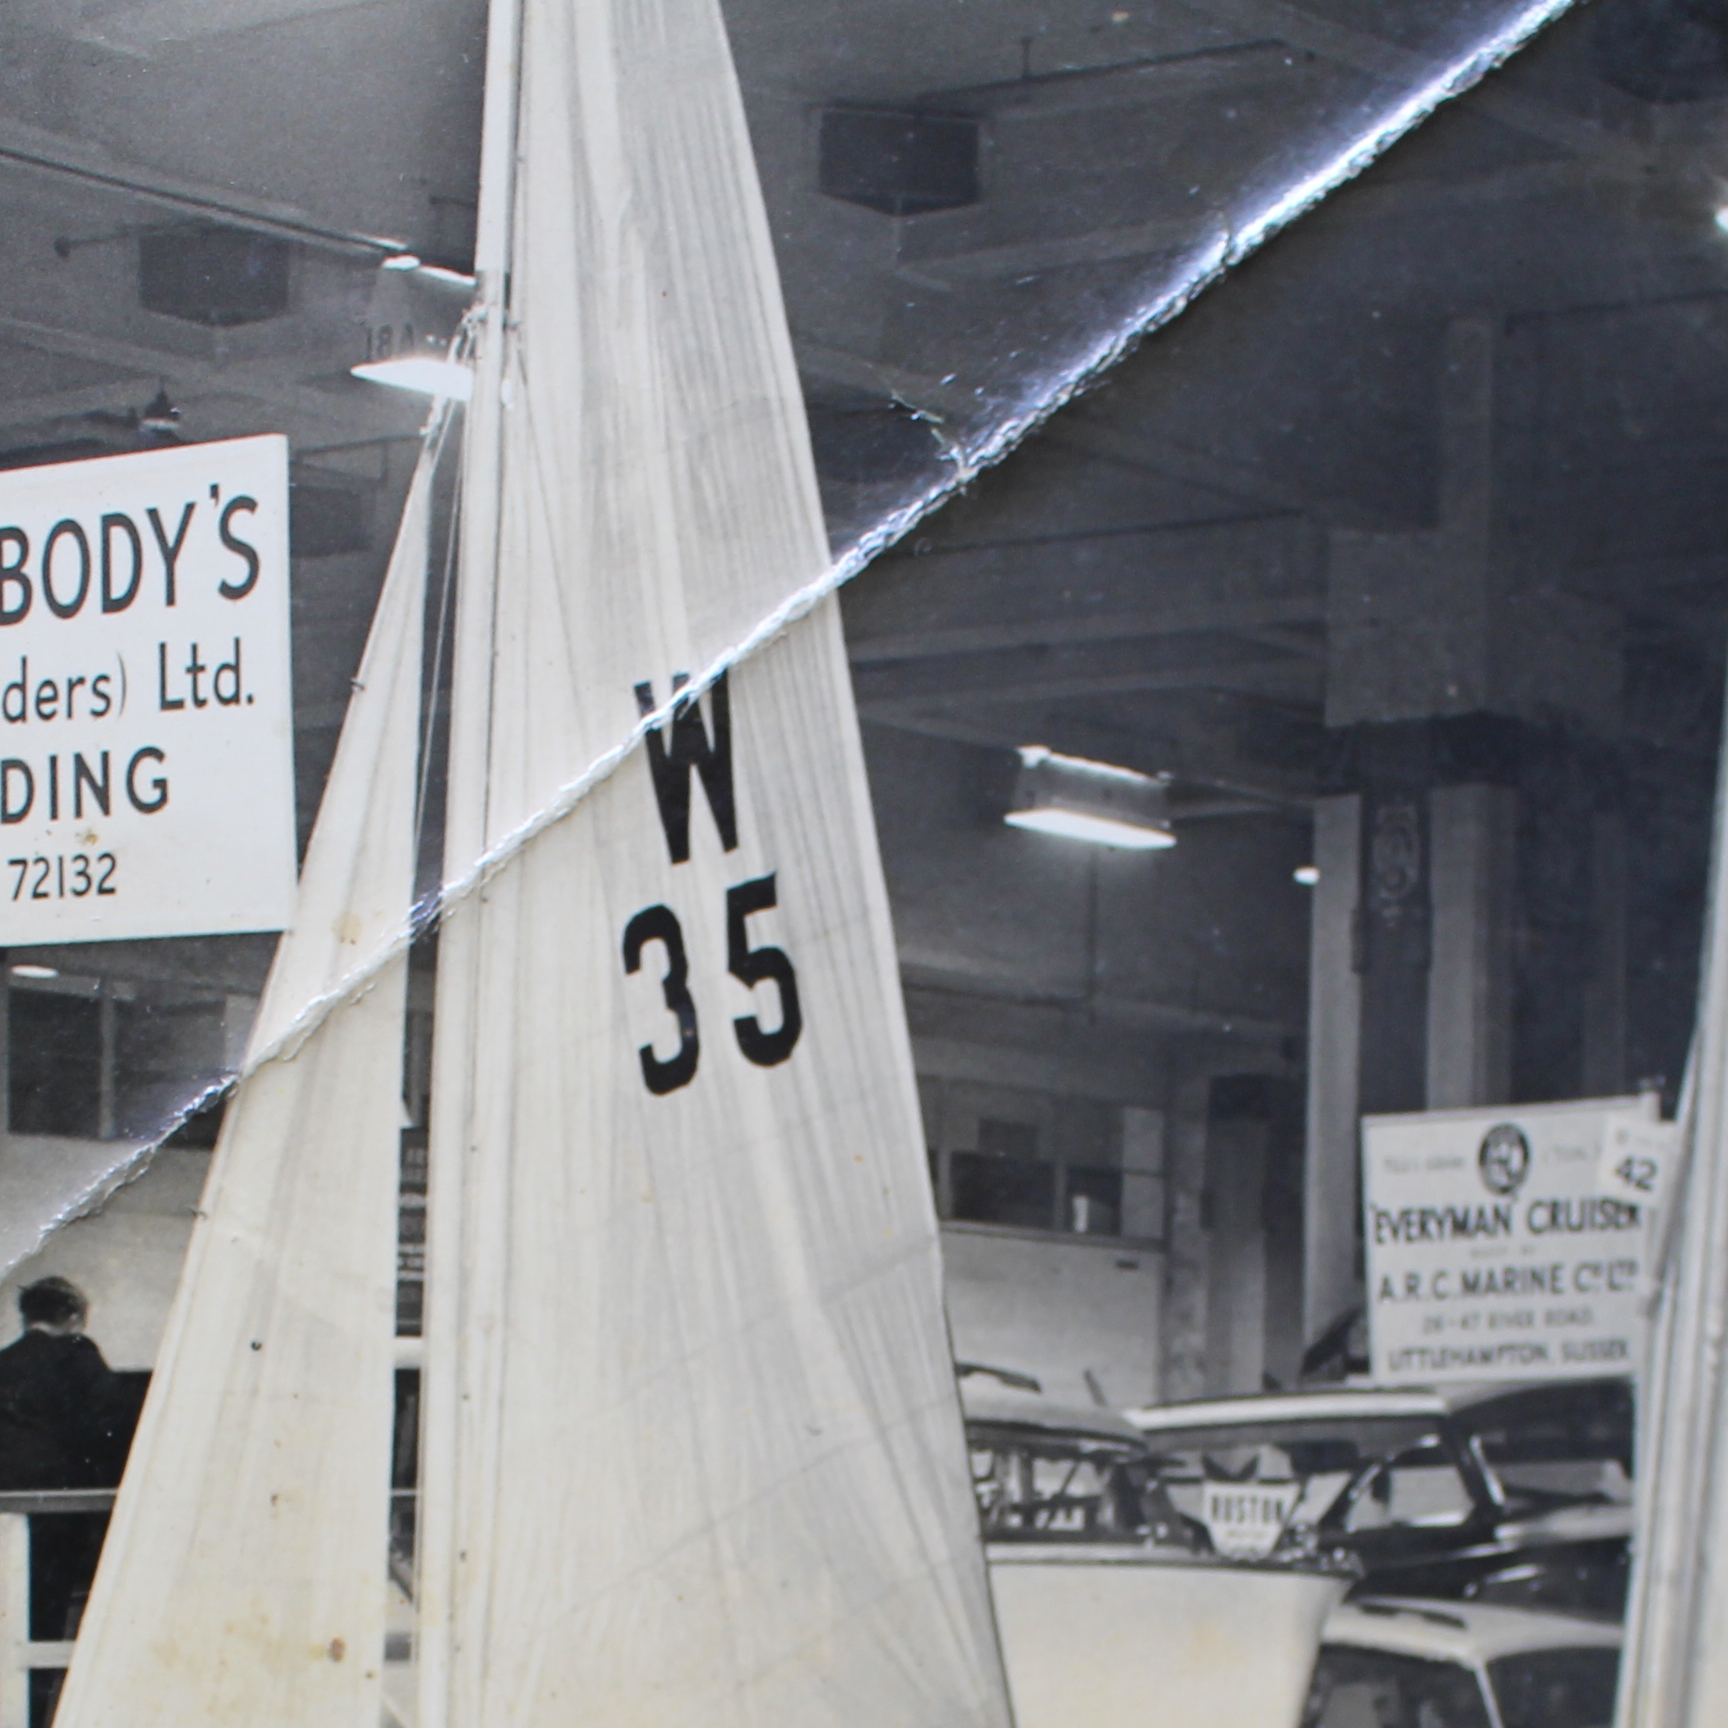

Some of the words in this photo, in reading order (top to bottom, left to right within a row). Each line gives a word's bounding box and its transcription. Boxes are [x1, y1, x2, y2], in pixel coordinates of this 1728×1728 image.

[157, 635, 256, 712] Ltd.
[632, 664, 739, 867] W
[6, 852, 119, 904] 72132
[622, 871, 804, 1096] 35
[1614, 1155, 1659, 1192] 42
[1526, 1196, 1643, 1236] CRUISER
[1460, 1262, 1565, 1297] MARINE
[1559, 1338, 1631, 1362] SUSSEX
